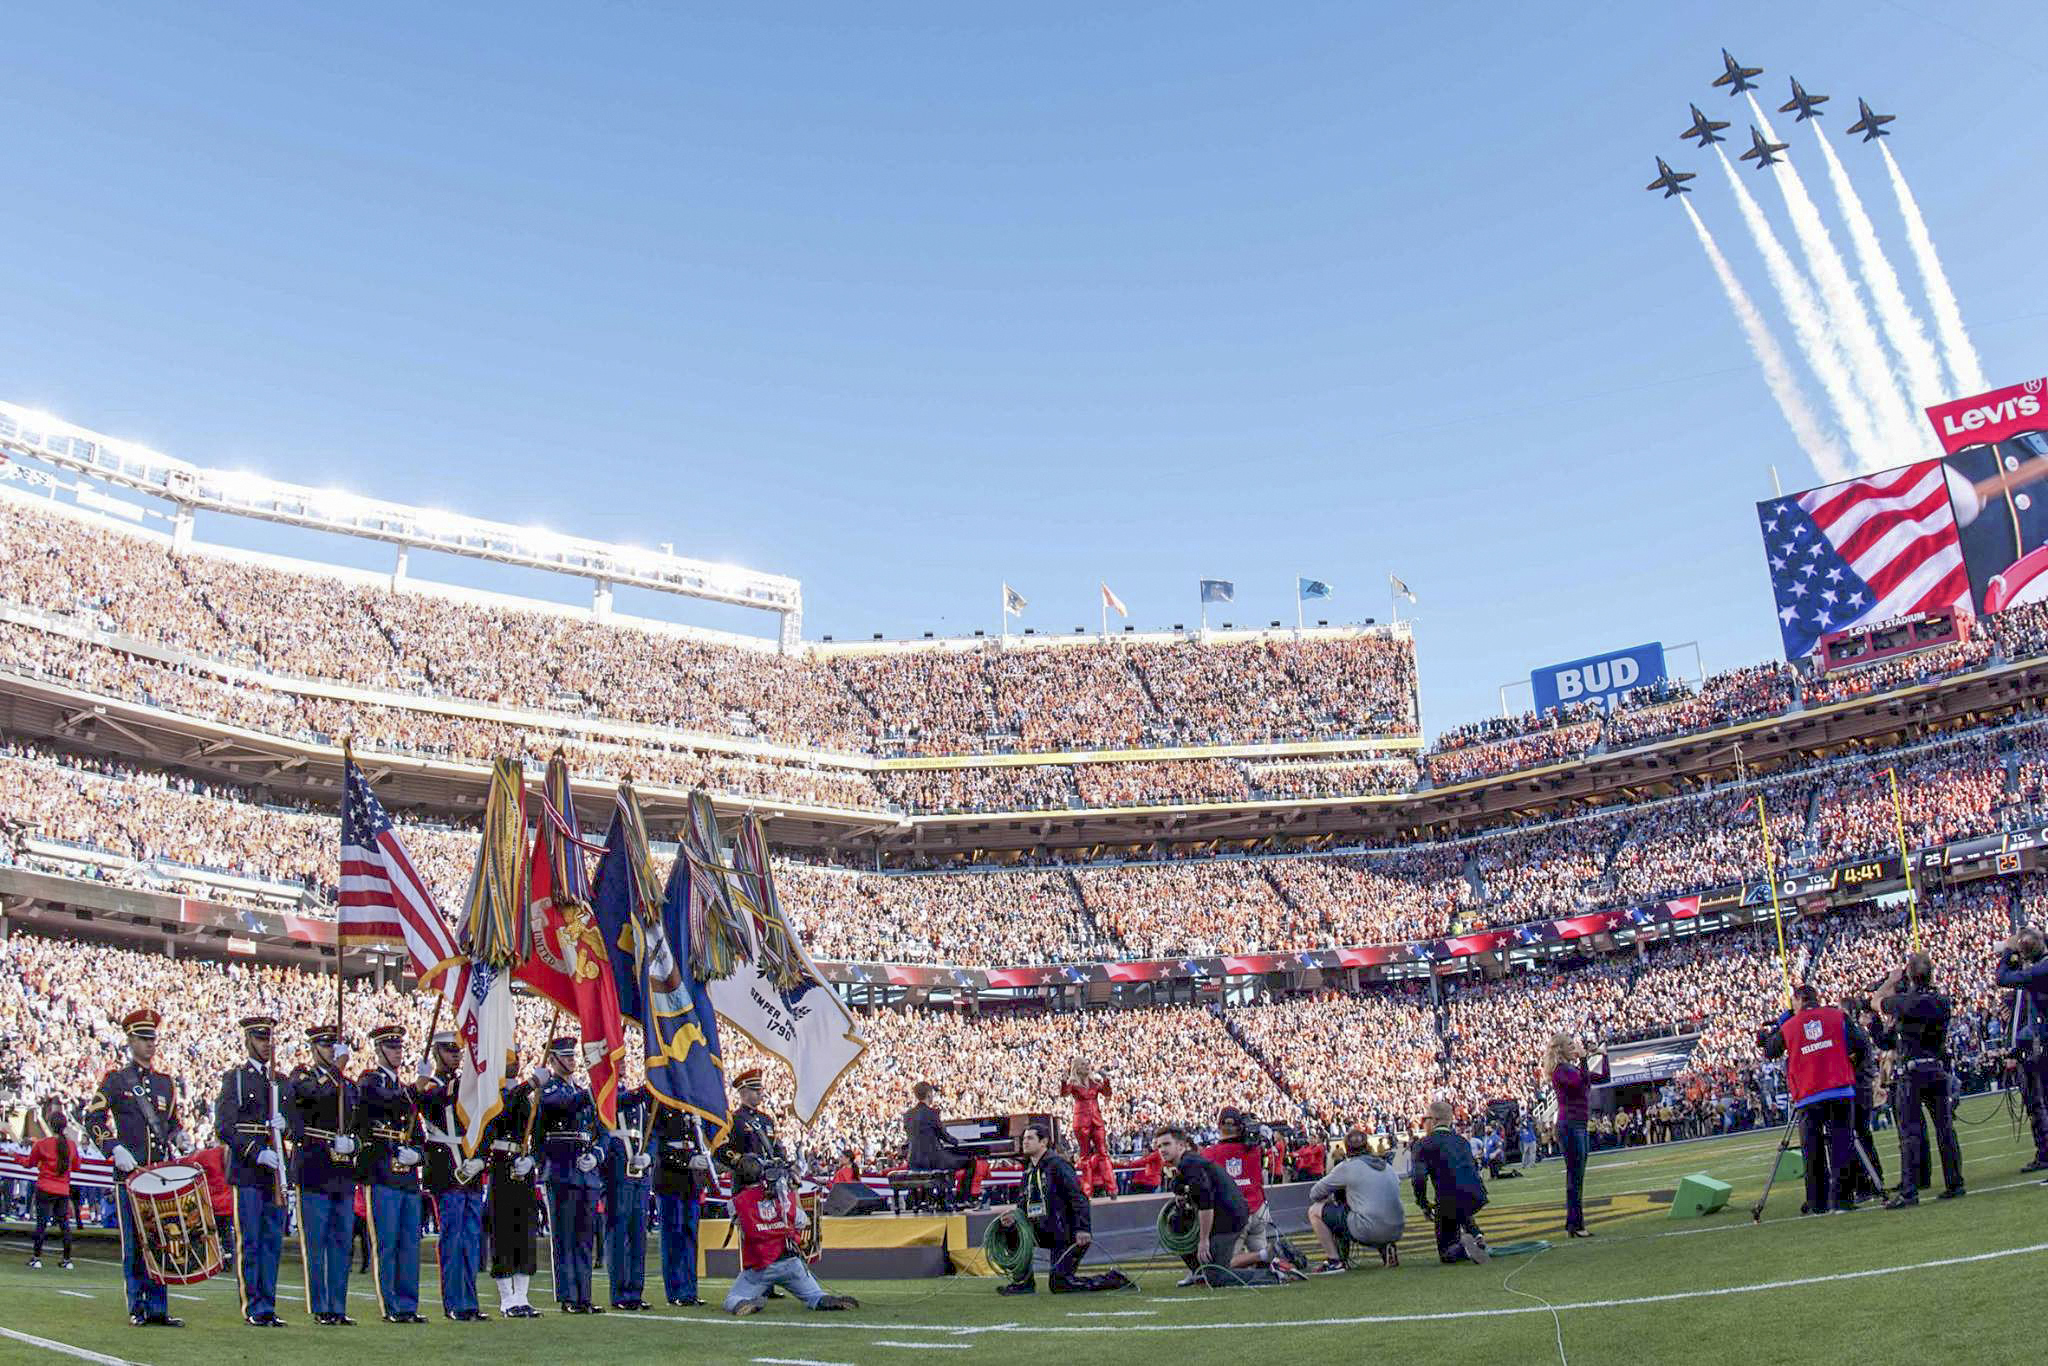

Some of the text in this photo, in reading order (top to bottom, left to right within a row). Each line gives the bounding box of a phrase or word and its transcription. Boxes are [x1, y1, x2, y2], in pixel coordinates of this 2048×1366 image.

[1885, 611, 1927, 628] STADIUM
[1555, 657, 1640, 700] BUD
[1925, 853, 1942, 867] 25
[1999, 854, 2017, 871] 25
[1807, 874, 1828, 885] TOL
[1844, 862, 1883, 883] 4:41
[533, 930, 557, 966] UNITED
[750, 986, 781, 1020] SEMPER
[766, 1018, 791, 1042] 1790
[1800, 1039, 1833, 1055] TELEVISION
